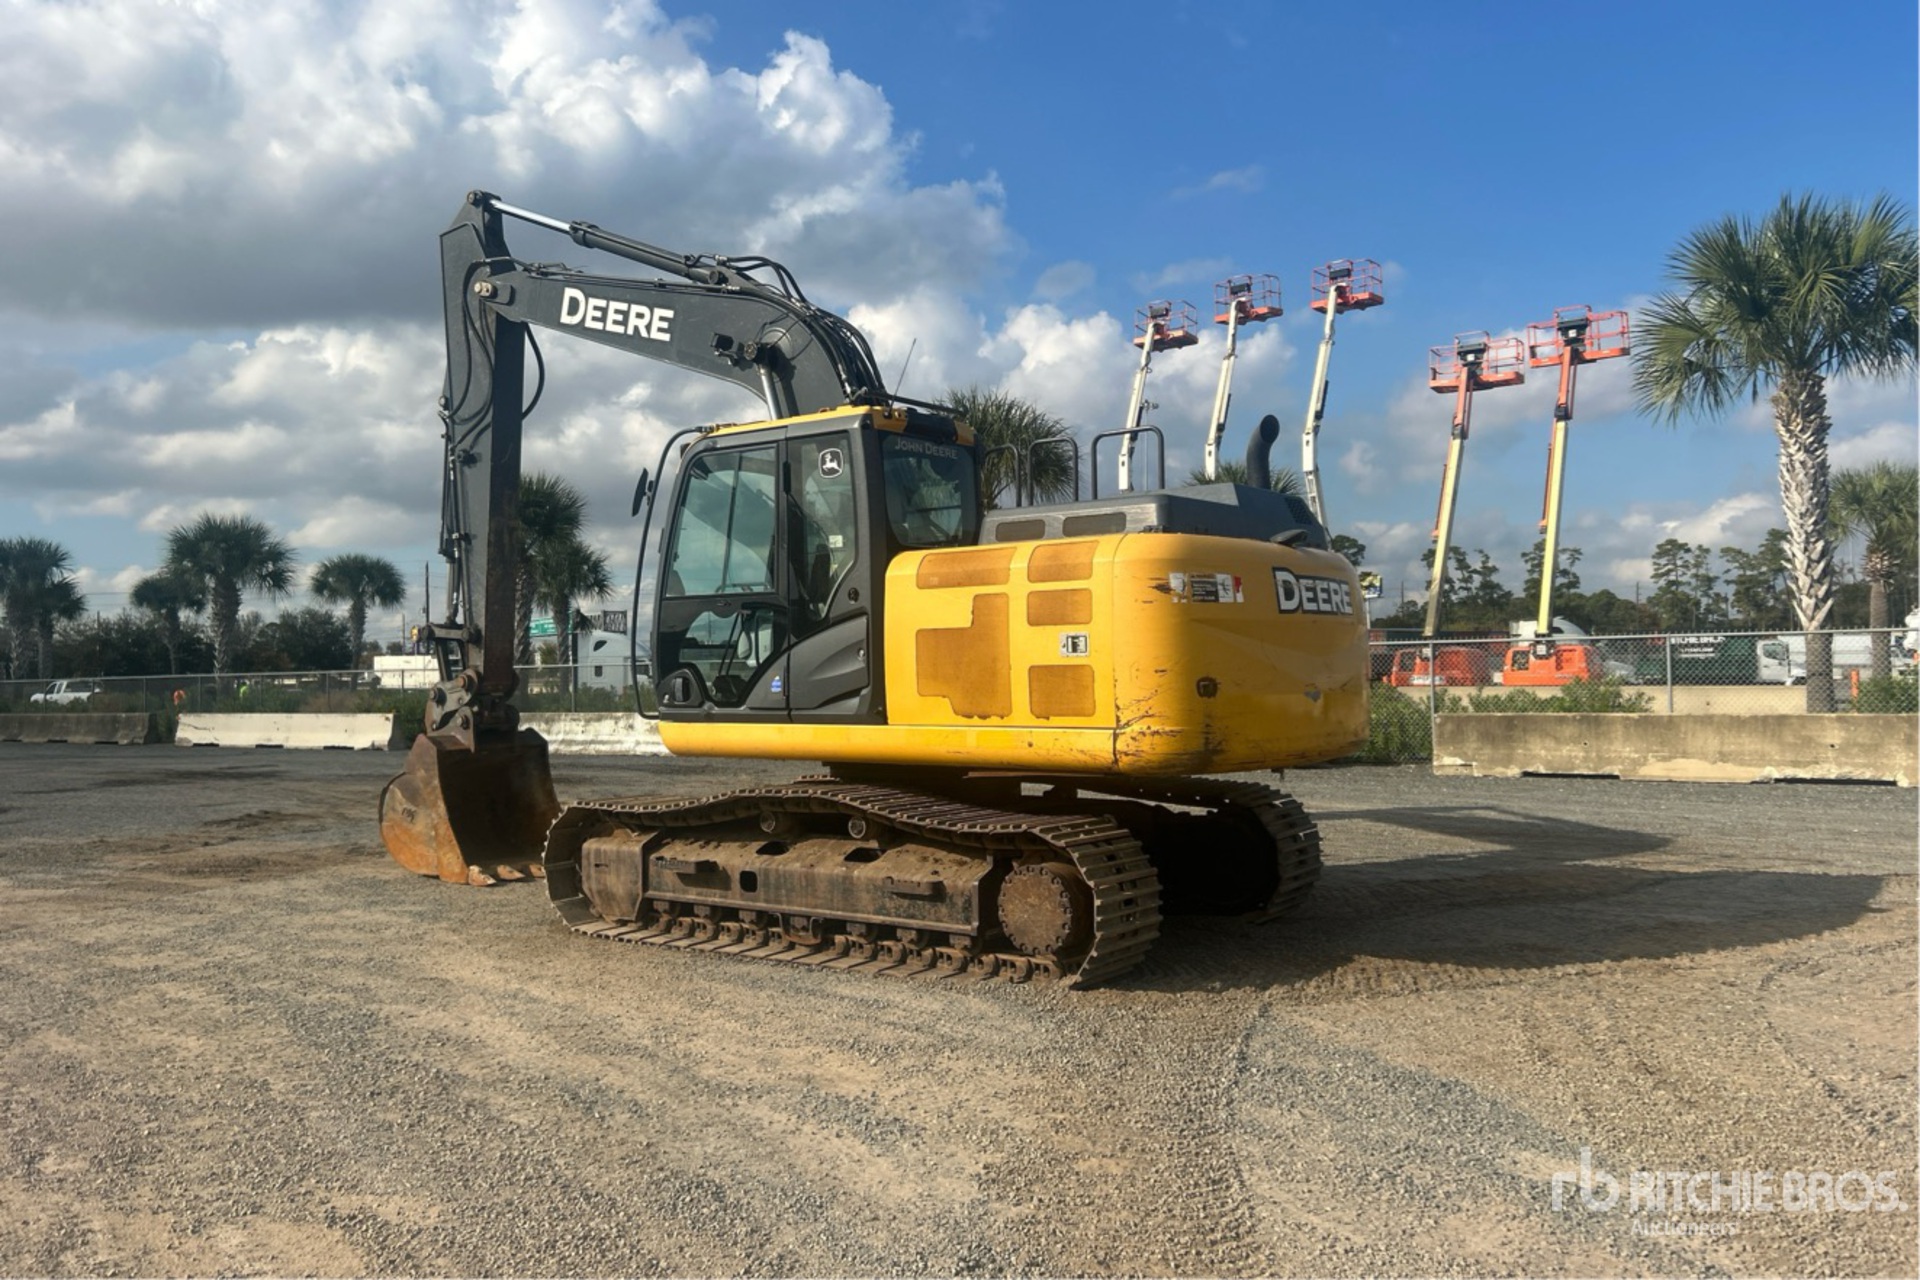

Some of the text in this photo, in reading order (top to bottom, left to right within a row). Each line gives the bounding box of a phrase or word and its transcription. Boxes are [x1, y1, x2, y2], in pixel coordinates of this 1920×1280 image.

[560, 287, 675, 342] DEERE
[895, 437, 959, 460] JOHN DEERE
[1273, 568, 1354, 615] DEERE
